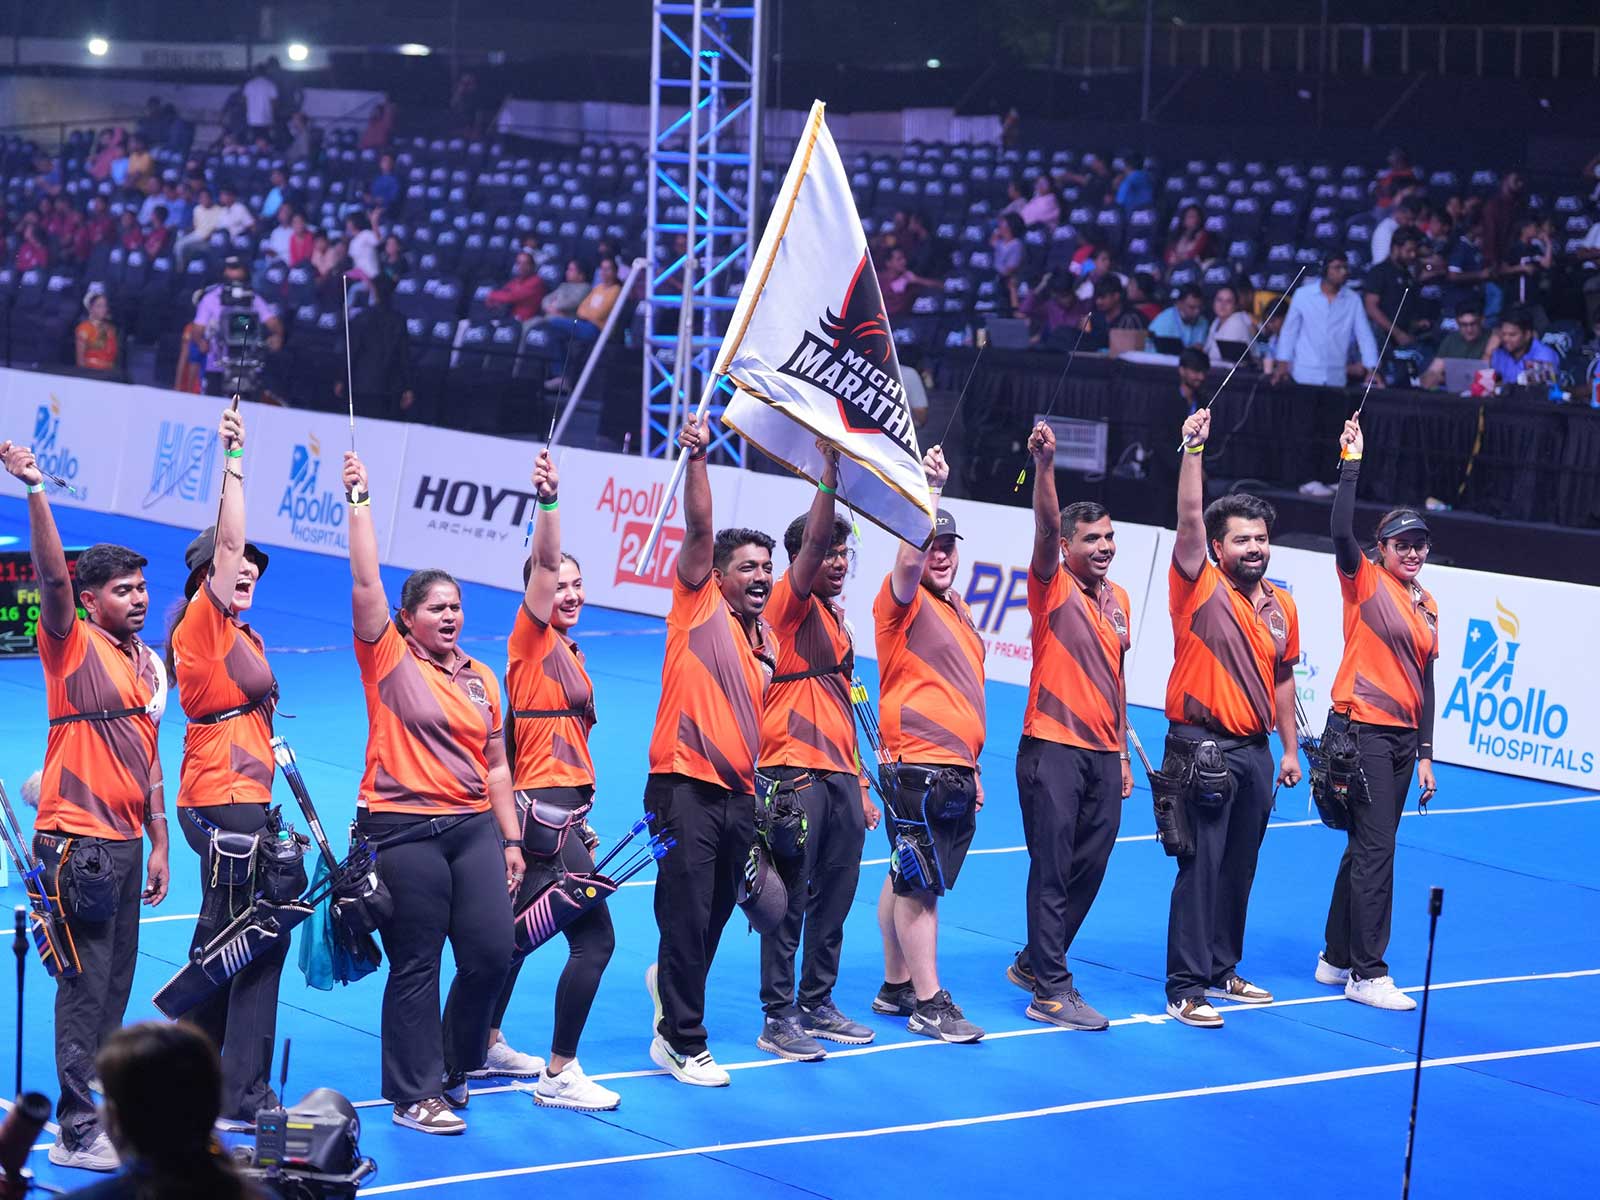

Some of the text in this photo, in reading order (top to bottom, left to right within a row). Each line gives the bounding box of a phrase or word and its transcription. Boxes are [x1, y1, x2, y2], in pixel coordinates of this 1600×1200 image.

[31, 443, 78, 480] pollo
[278, 485, 344, 535] Apollo
[413, 475, 538, 527] HOYT
[294, 524, 350, 550] HOSPITAL
[427, 519, 509, 541] ARCHERY
[964, 561, 1033, 640] AP
[993, 640, 1033, 661] PREMIE
[1441, 676, 1569, 746] Apollo
[1477, 733, 1595, 774] HOSPITALS
